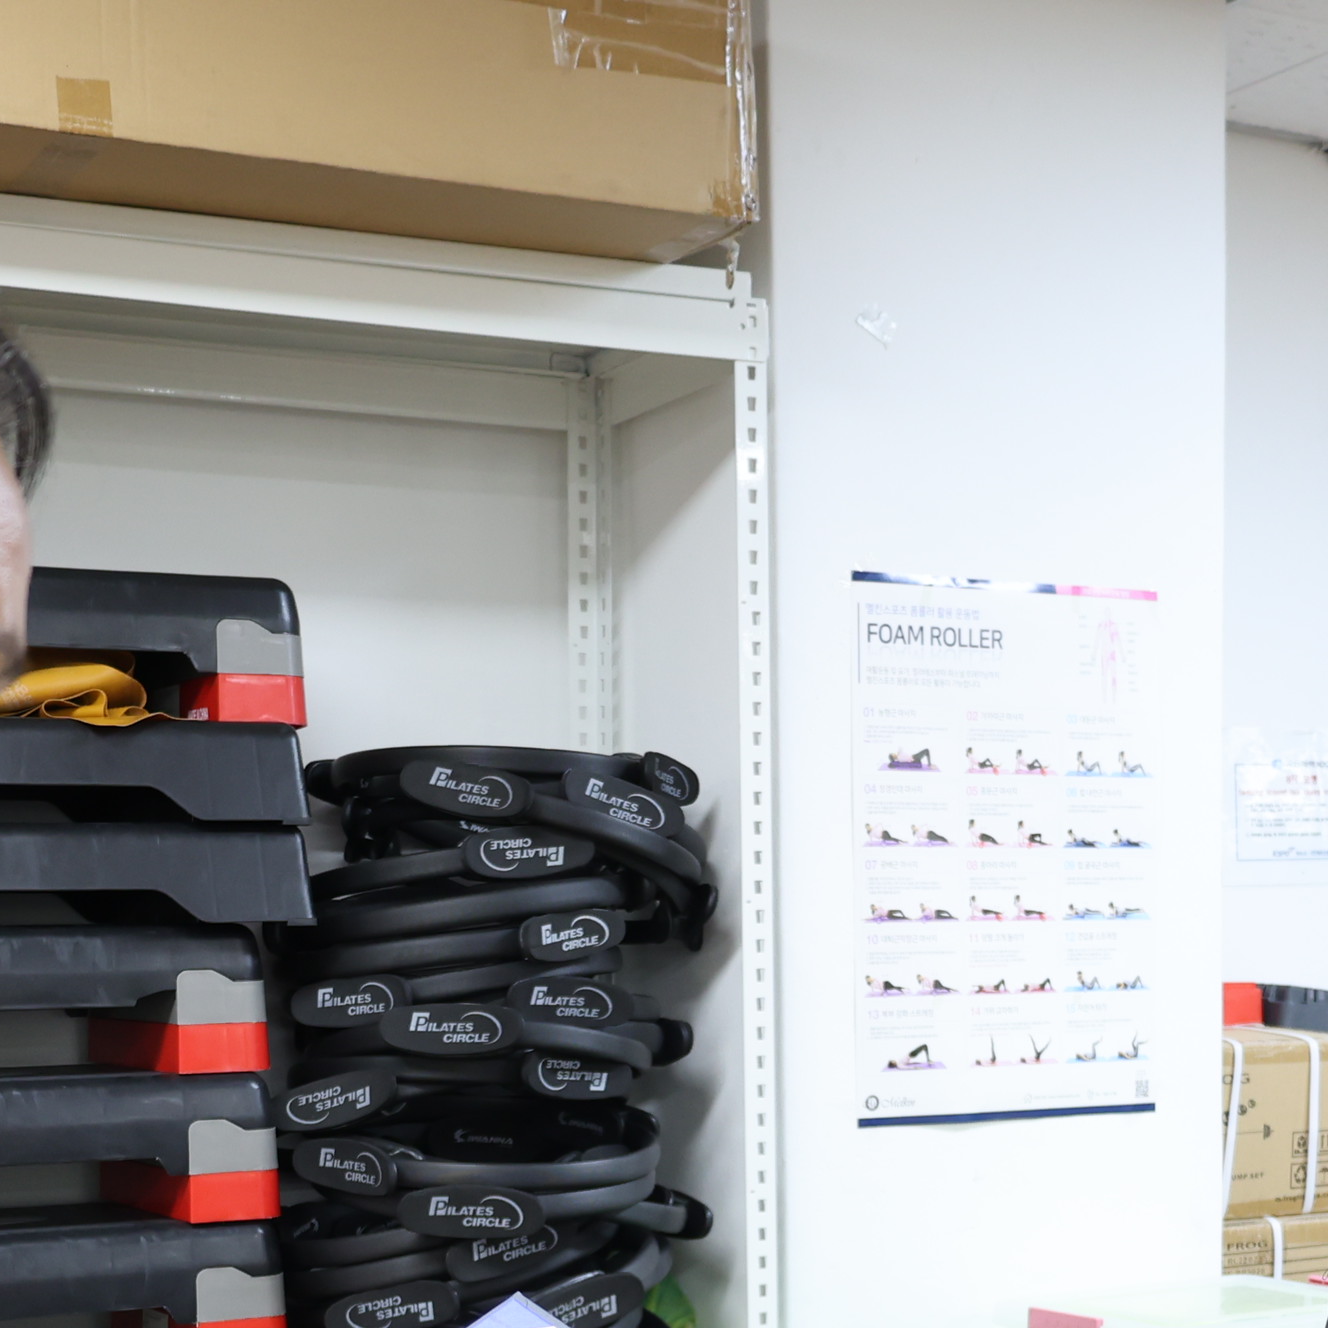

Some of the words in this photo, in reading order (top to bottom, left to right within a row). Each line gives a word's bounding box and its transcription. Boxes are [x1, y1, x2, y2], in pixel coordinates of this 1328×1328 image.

[866, 622, 925, 646] FOAM
[929, 625, 1004, 650] ROLLER
[428, 766, 490, 796] PILATES
[457, 793, 502, 808] CIRCLE
[584, 777, 639, 812] PILATES
[608, 806, 653, 828] CIRCLE
[490, 837, 532, 851] CIRCLE
[505, 846, 565, 867] PILATES
[540, 923, 585, 946] PILATES
[561, 935, 599, 952] CIRCLE
[316, 987, 373, 1009] PILATES
[530, 985, 586, 1006] PILATES
[347, 1002, 386, 1017] CIRCLE
[555, 1006, 600, 1018] CIRCLE
[408, 1011, 474, 1033] PILATES
[442, 1032, 490, 1044] CIRCLE
[545, 1059, 581, 1070] CIRCLE
[556, 1070, 608, 1092] PILATES
[297, 1085, 341, 1107] CIRCLE
[315, 1085, 371, 1112] PILATES
[318, 1147, 367, 1172] PILATES
[344, 1170, 377, 1186] CIRCLE
[1232, 1172, 1248, 1182] UMP
[428, 1195, 495, 1217] PILATES
[461, 1216, 512, 1229] CIRCLE
[472, 1235, 529, 1262] PILATES
[502, 1240, 547, 1263] CIRCLE
[357, 1294, 403, 1315] CIRCLE
[376, 1300, 435, 1322] PILATES
[551, 1295, 585, 1317] CIRCL
